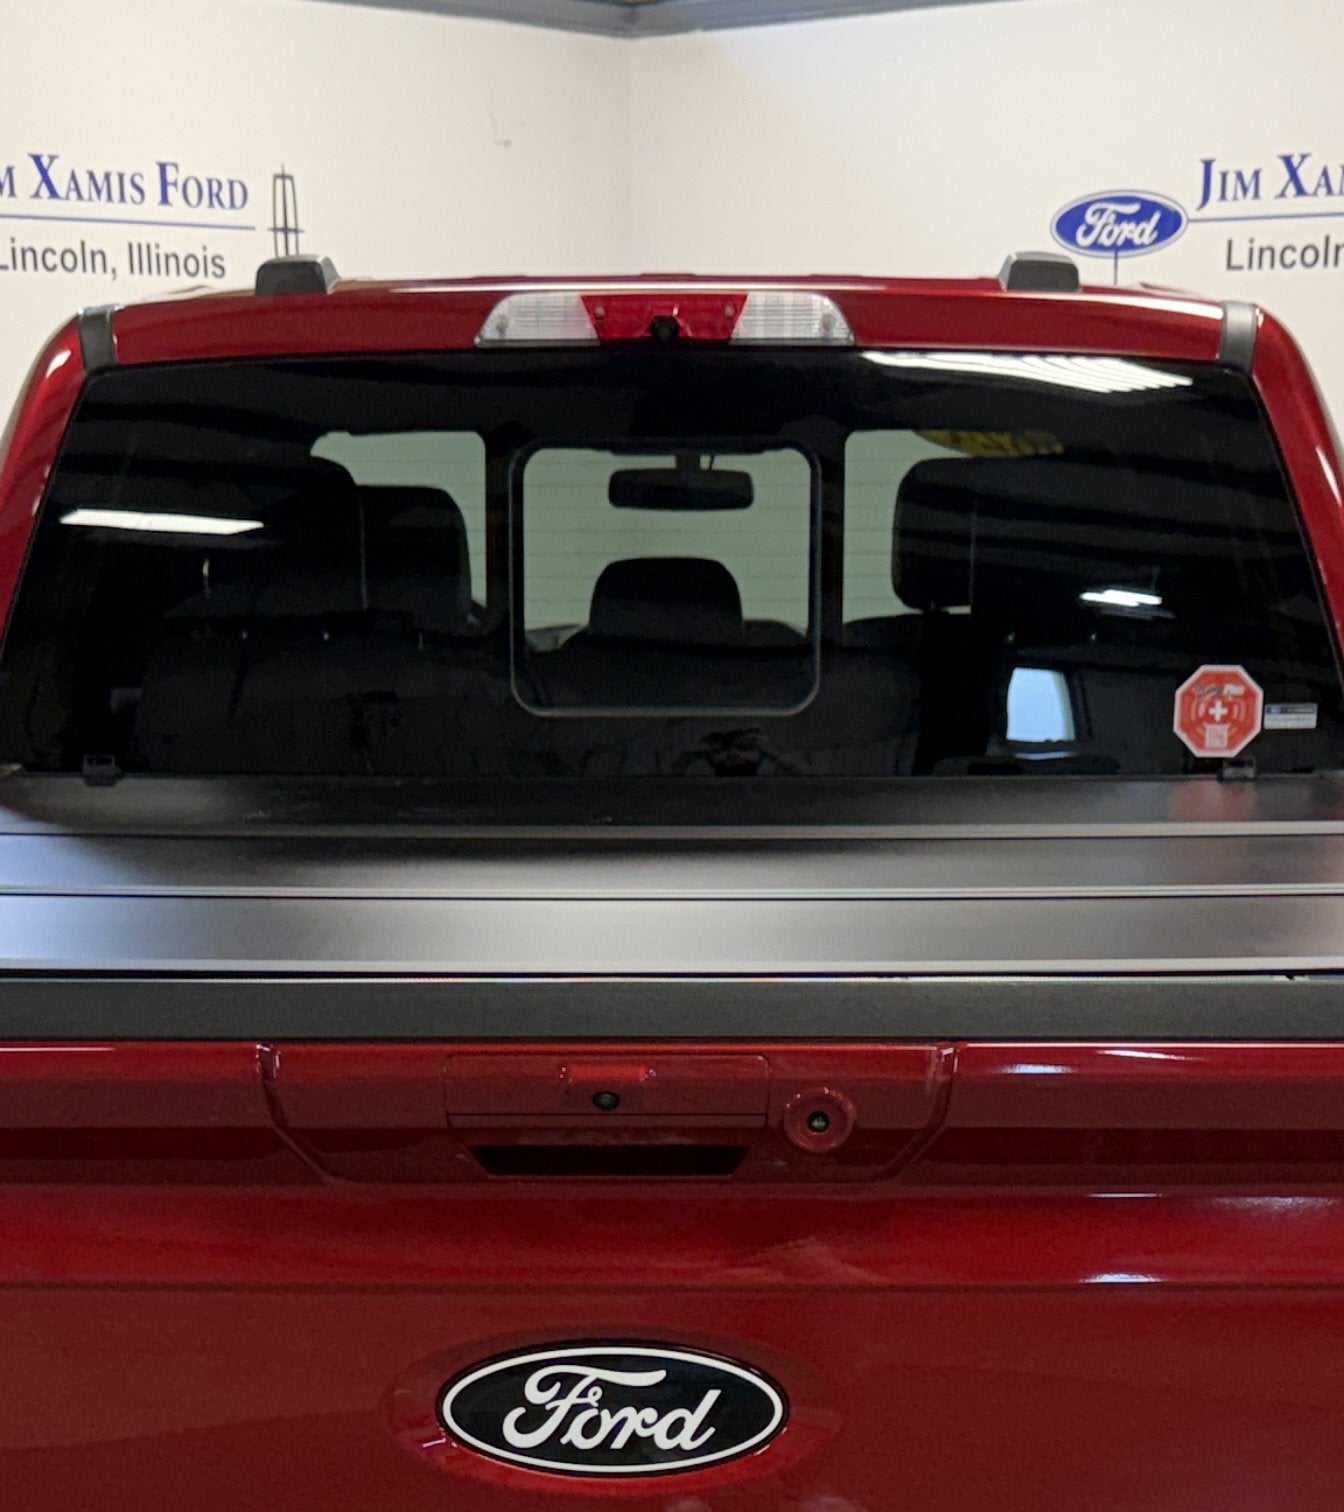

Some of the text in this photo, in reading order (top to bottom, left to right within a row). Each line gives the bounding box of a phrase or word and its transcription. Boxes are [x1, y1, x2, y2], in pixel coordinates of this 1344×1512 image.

[27, 152, 146, 206] XAMIS
[155, 160, 249, 211] FORD
[1196, 158, 1262, 211] JIM
[1074, 200, 1161, 248] Ford
[127, 241, 227, 279] Illinois
[501, 1364, 722, 1451] Ford
